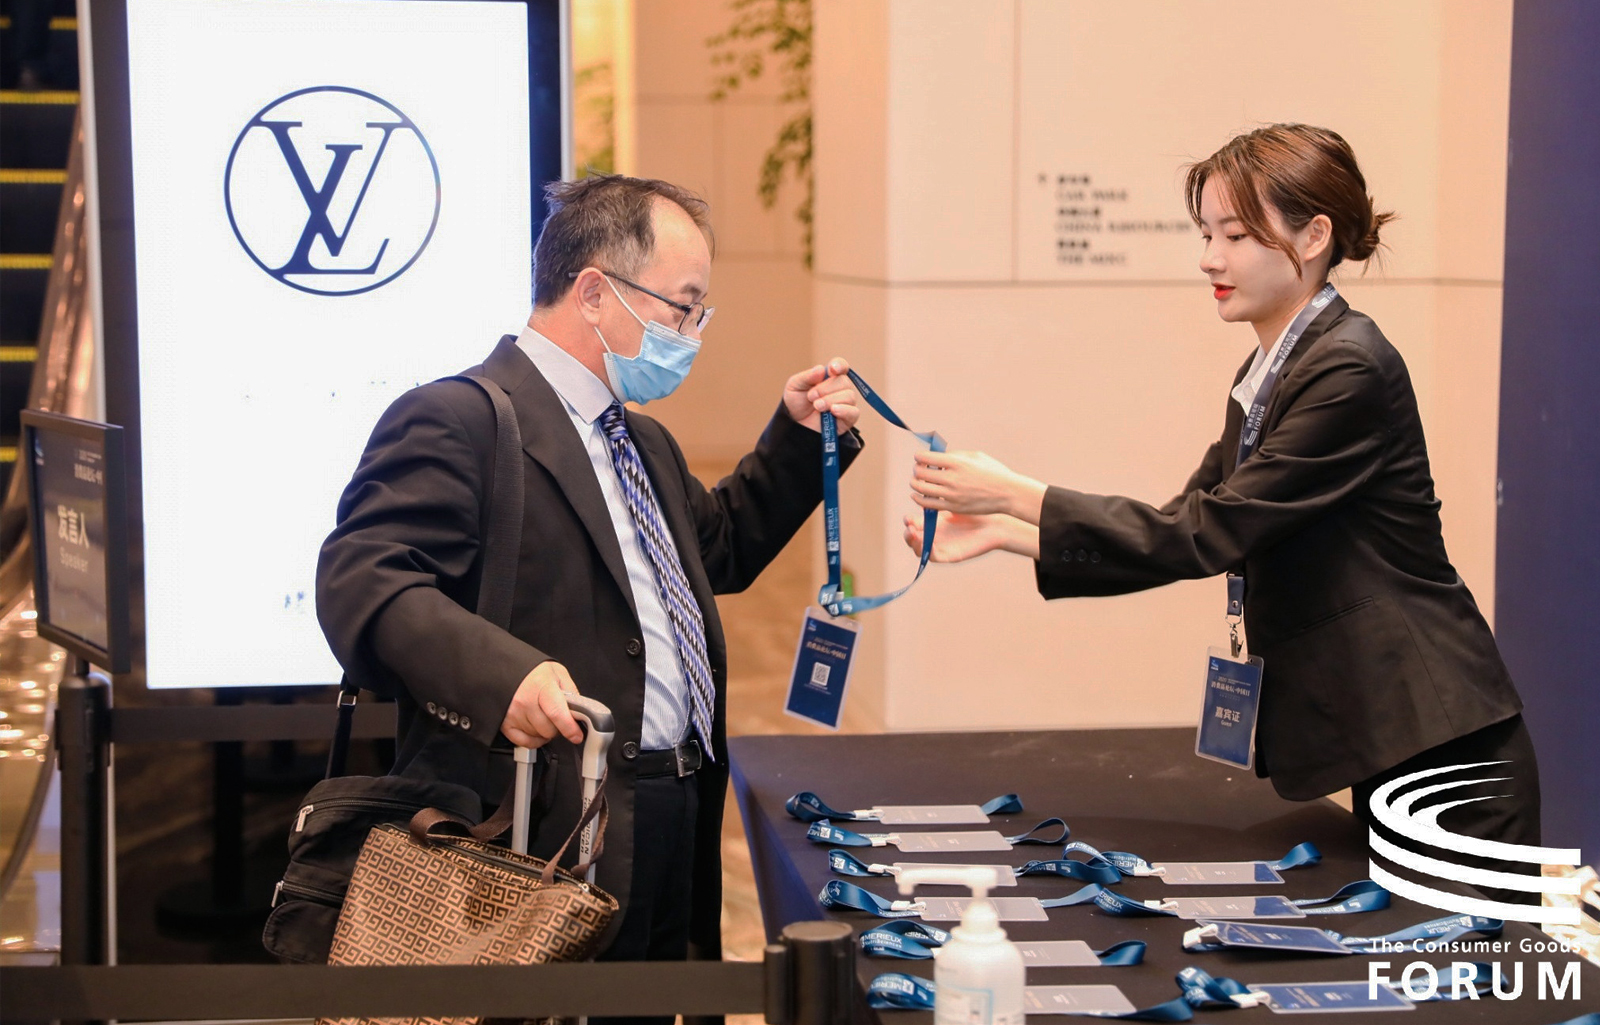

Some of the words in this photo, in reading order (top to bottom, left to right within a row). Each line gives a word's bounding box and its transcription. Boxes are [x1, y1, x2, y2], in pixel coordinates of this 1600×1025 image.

[823, 412, 831, 442] MERIEU
[1253, 405, 1266, 431] FORUM
[57, 505, 90, 549] 发言人
[1215, 706, 1241, 723] 嘉宾证
[864, 932, 902, 945] MERIEUX
